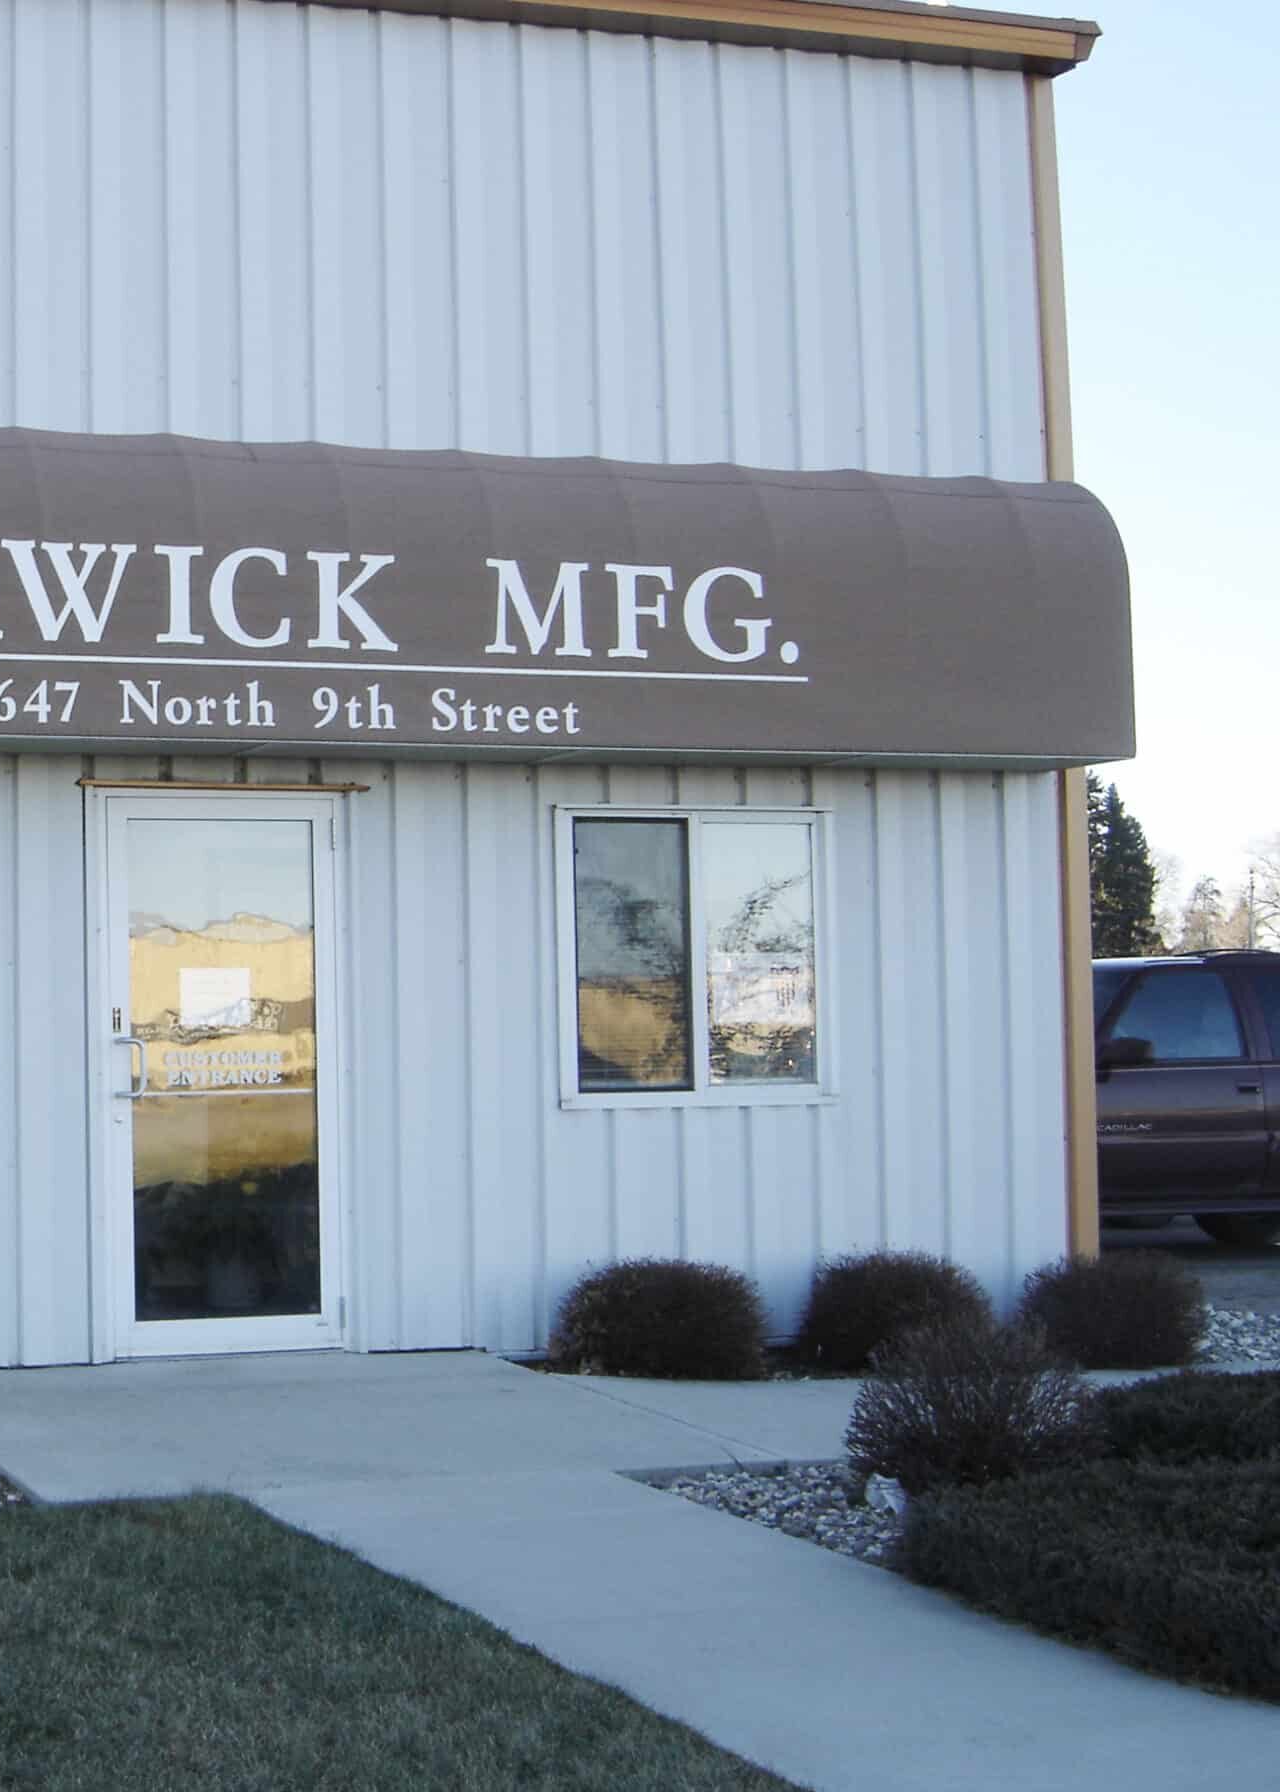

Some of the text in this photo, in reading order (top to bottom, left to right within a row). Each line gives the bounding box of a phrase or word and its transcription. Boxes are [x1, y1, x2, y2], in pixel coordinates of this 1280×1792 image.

[483, 557, 800, 665] MFG.
[118, 679, 277, 728] North
[311, 683, 399, 731] 9th
[430, 686, 583, 735] Street
[163, 1051, 282, 1066] CUSTOMER
[167, 1069, 283, 1087] ENTRANCE
[1097, 1122, 1152, 1132] CADILLAC
